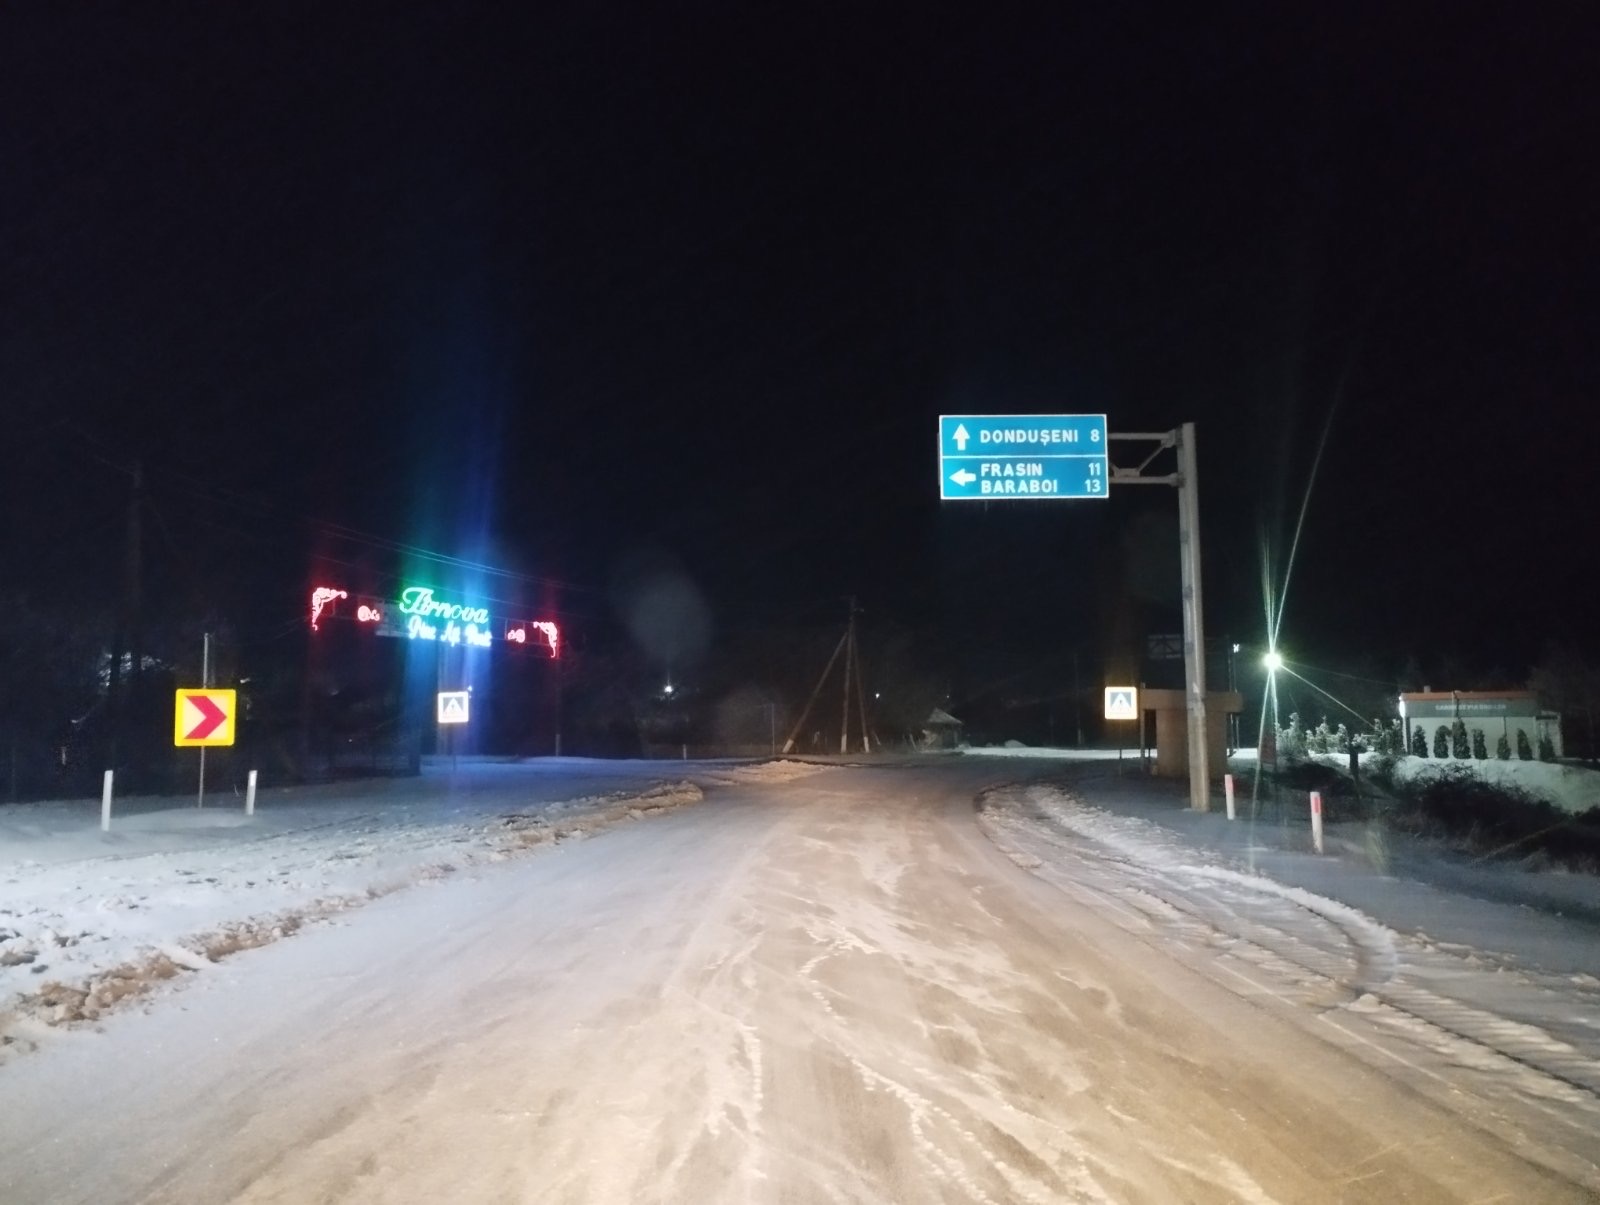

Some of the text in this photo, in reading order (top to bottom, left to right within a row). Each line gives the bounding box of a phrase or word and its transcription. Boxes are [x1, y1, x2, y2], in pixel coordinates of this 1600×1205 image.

[980, 428, 1100, 446] DONDUȘENI 8
[981, 462, 1101, 477] FRASIN 11
[981, 479, 1101, 494] BARABOI 13
